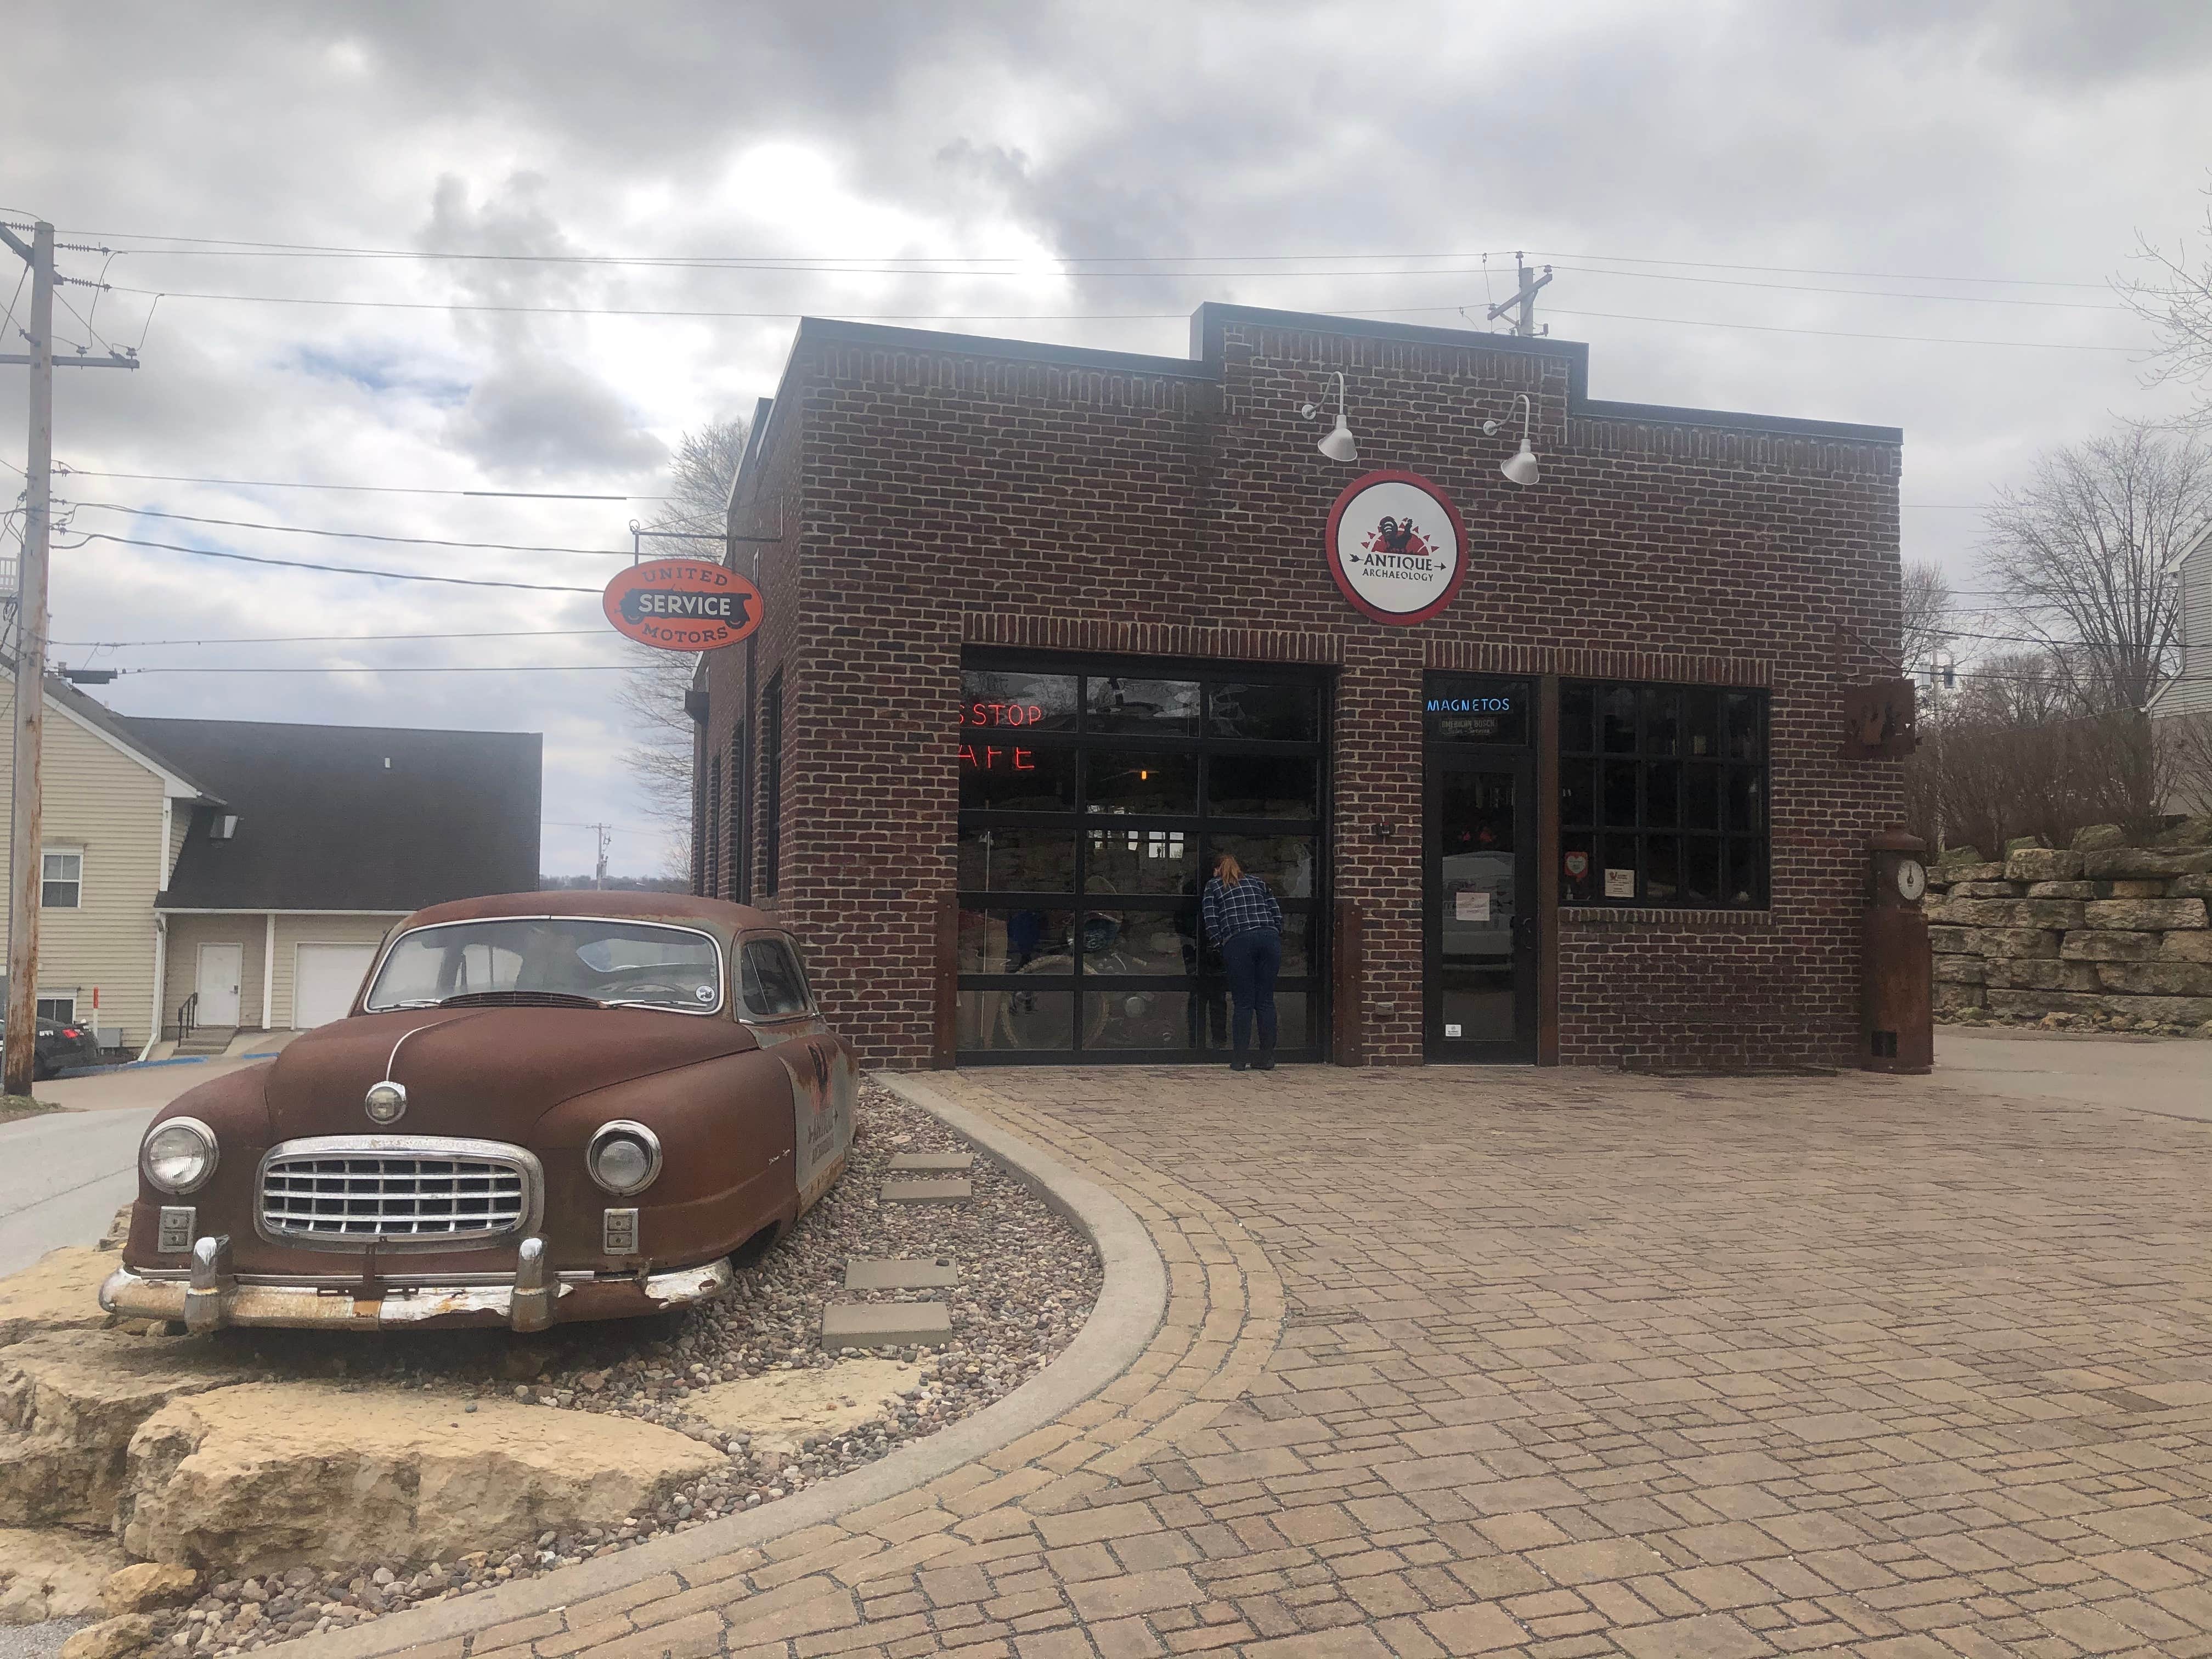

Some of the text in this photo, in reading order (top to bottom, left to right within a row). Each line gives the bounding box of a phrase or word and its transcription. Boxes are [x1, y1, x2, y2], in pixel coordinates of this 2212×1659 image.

[1364, 554, 1432, 571] ANTIQUE
[642, 567, 728, 586] UNITED
[1362, 568, 1434, 582] ARCHAEOLOGY
[638, 594, 731, 616] SERVICE
[642, 623, 729, 643] MOTORS
[1427, 698, 1510, 712] MAGNETOS
